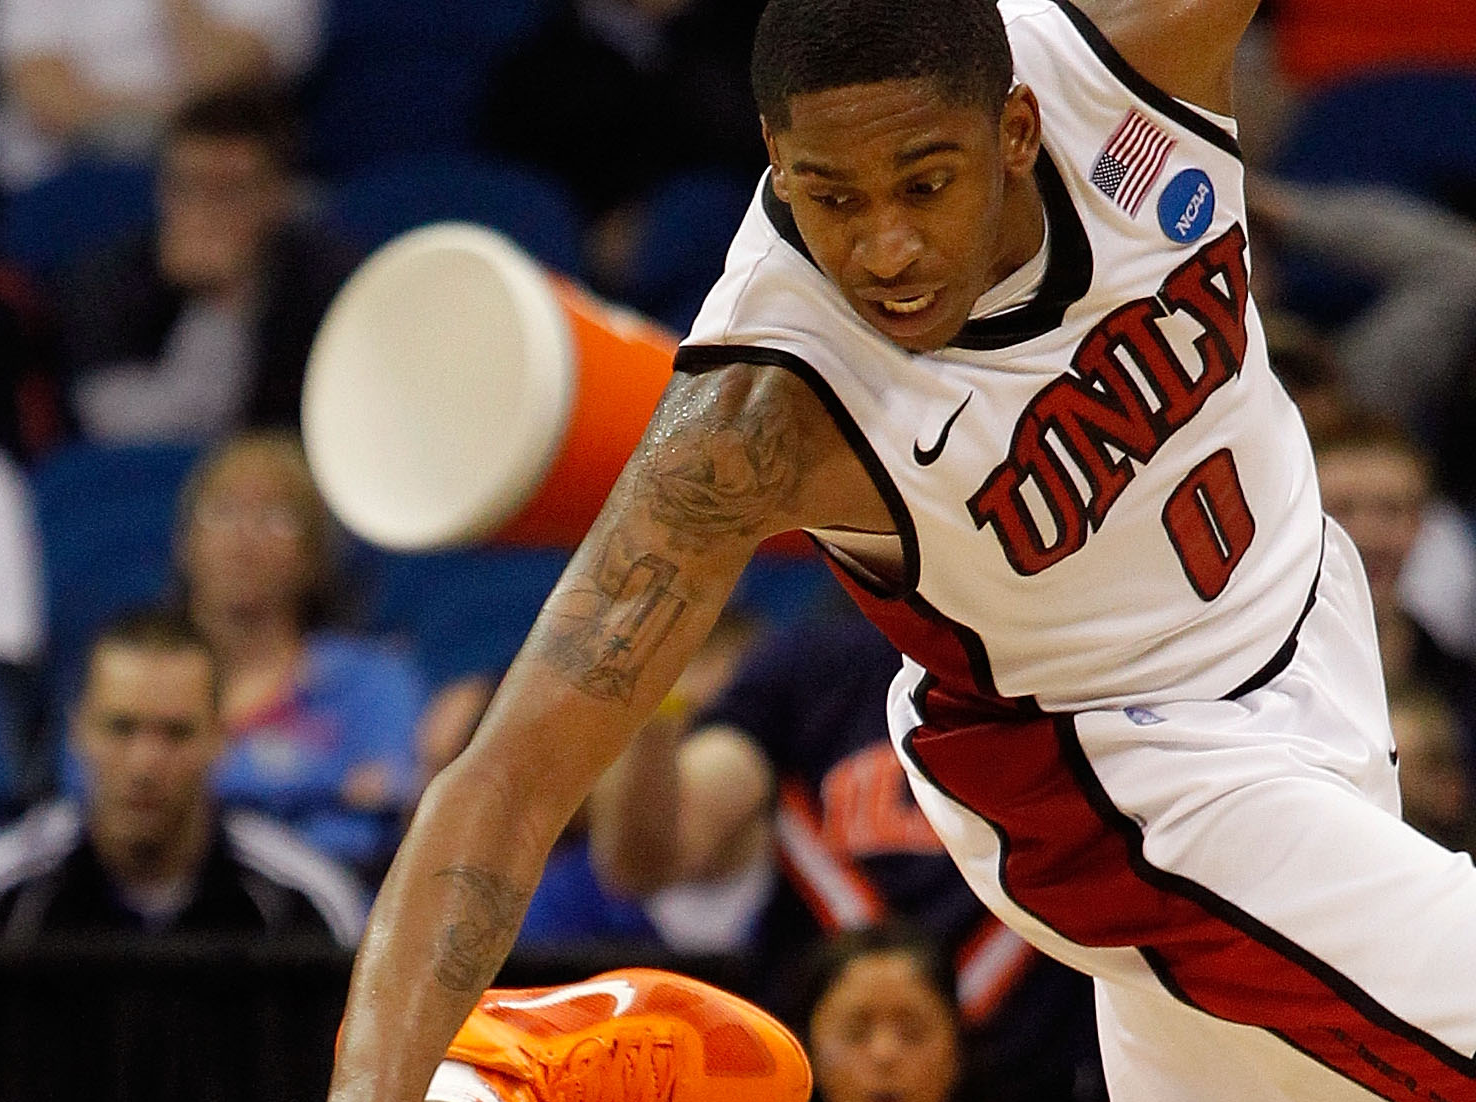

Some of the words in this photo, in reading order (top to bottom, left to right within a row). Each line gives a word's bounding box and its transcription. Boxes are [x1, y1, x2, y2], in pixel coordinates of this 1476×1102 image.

[1174, 182, 1210, 237] NCAA
[966, 222, 1250, 577] UNLV
[1161, 447, 1256, 602] 0
